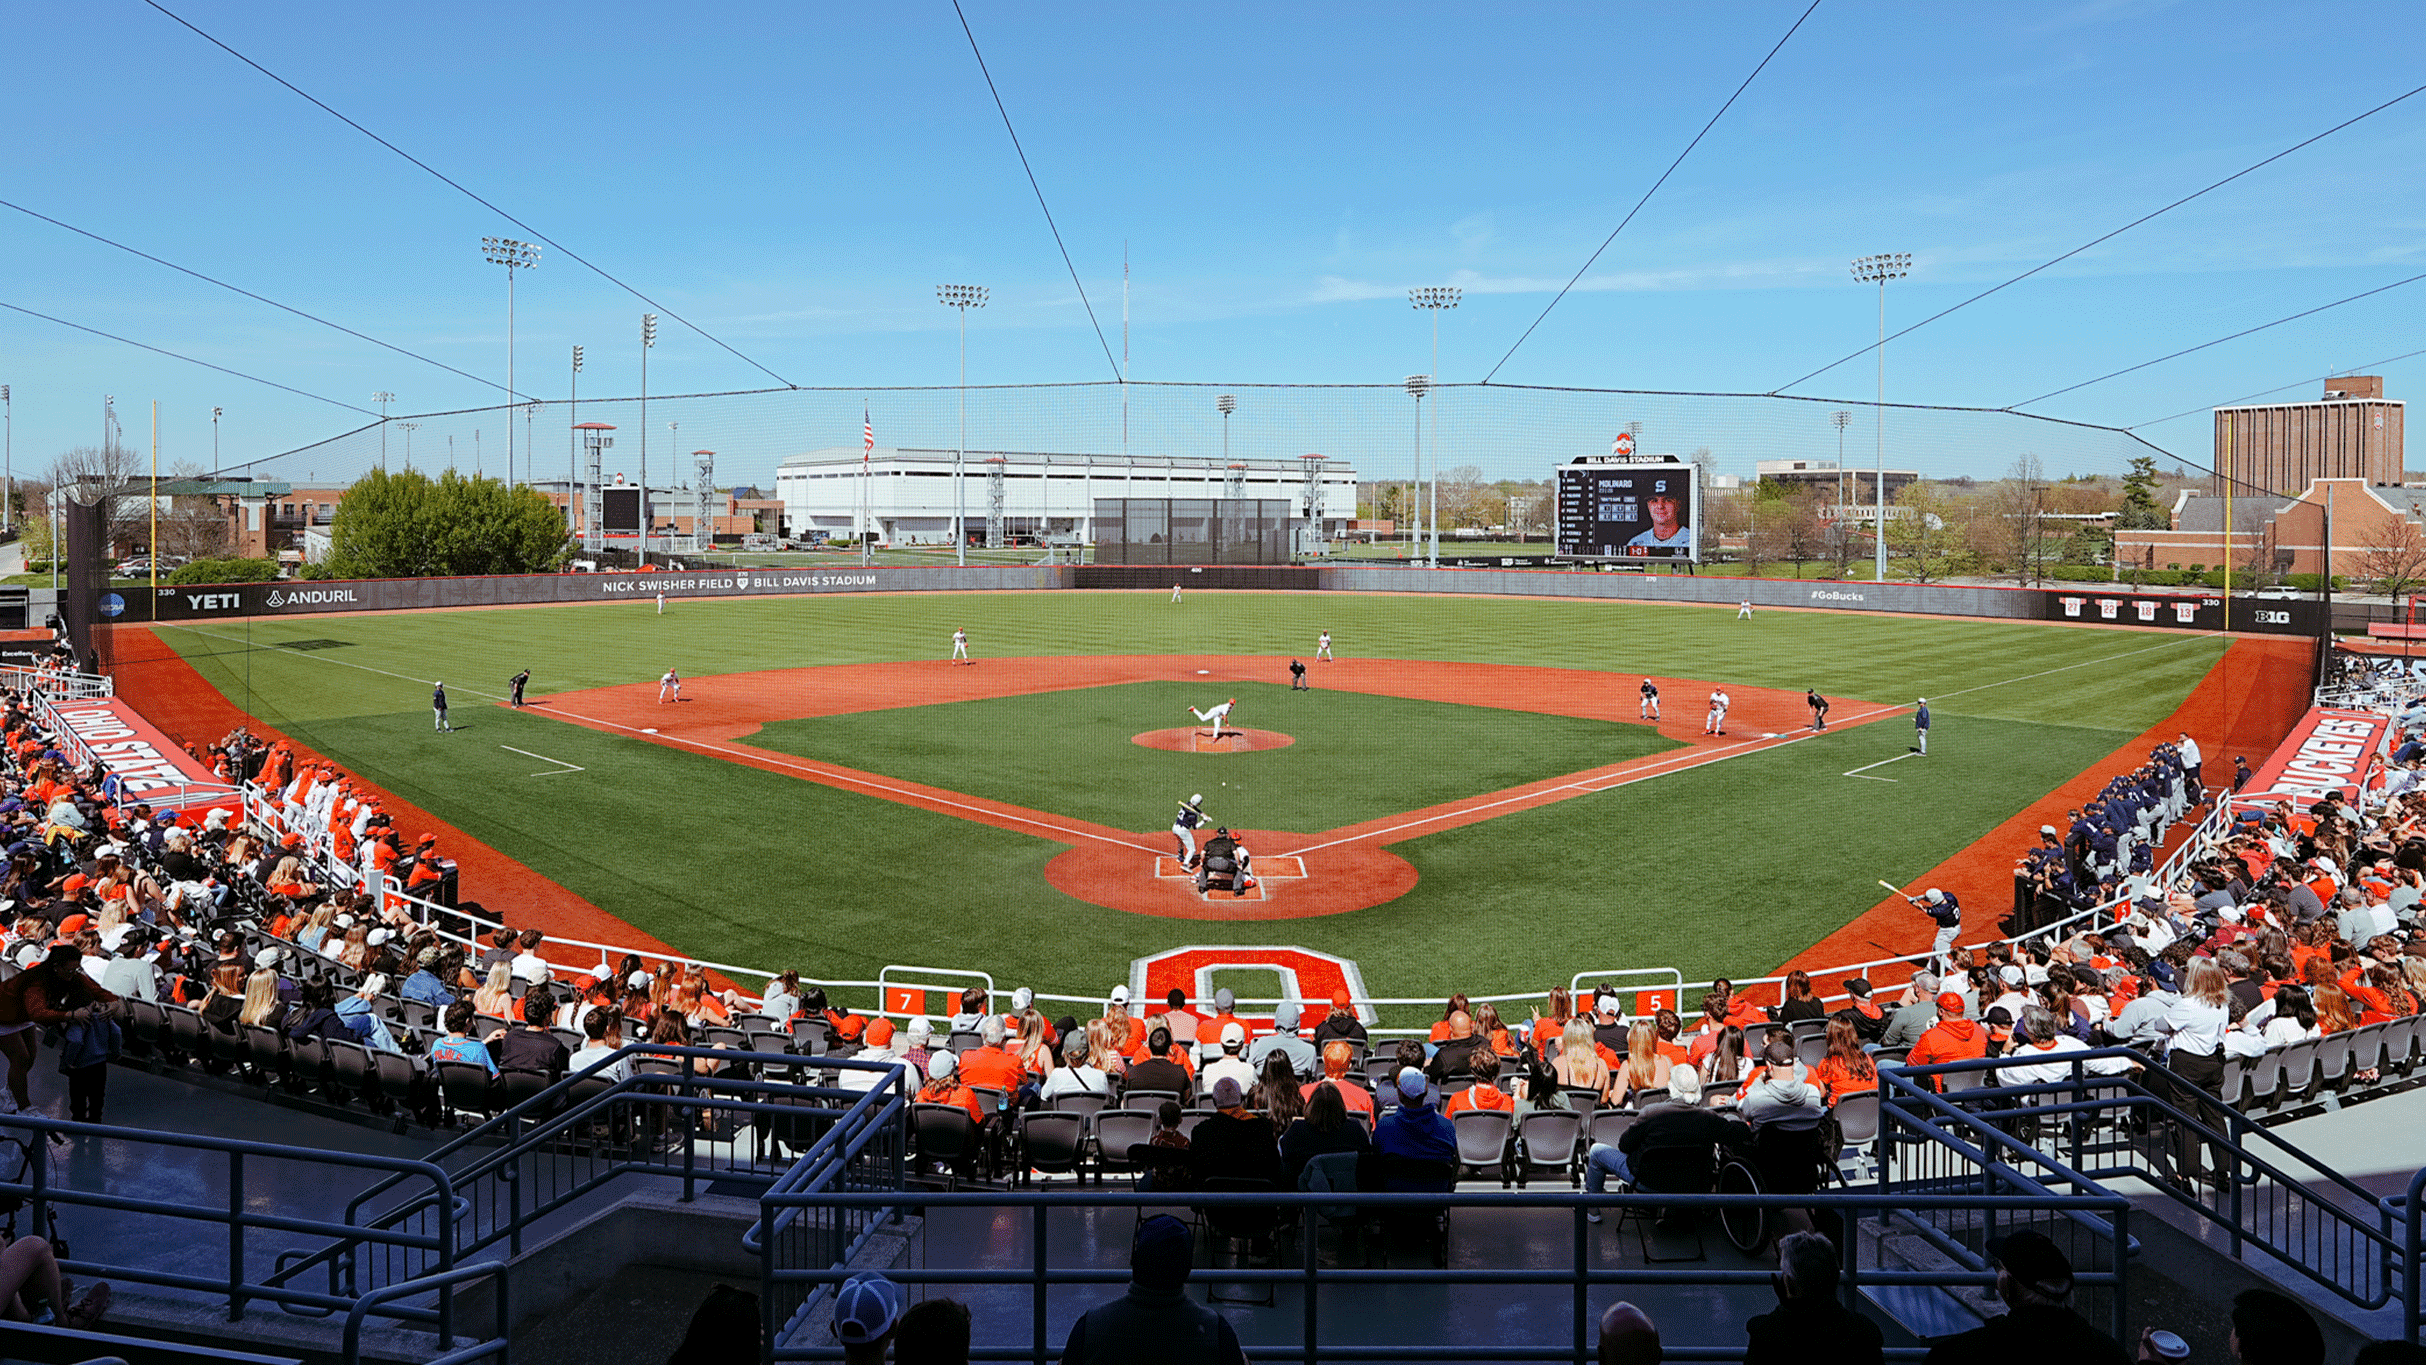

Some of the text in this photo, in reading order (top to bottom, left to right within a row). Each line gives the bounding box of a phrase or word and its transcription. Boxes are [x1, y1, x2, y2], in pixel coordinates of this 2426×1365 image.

[1586, 455, 1664, 464] BILL DAVIS STADIUM
[603, 581, 635, 592] NICK
[639, 580, 695, 591] SWISHER
[699, 578, 733, 589] FIELD
[754, 577, 779, 587] BILL
[783, 576, 819, 586] DAVIS
[819, 575, 876, 586] STADIUM
[158, 588, 175, 596] 330
[287, 589, 357, 604] ANDURIL
[1811, 590, 1864, 601] #GoBucks
[187, 593, 240, 610] YETI
[2104, 604, 2115, 614] 22
[2141, 606, 2152, 616] 18
[2180, 608, 2191, 618] 13
[60, 709, 138, 740] OHIO
[2267, 718, 2377, 800] BUCKEYES
[89, 741, 195, 792] STATE
[900, 993, 911, 1010] 7
[1650, 995, 1661, 1011] 5
